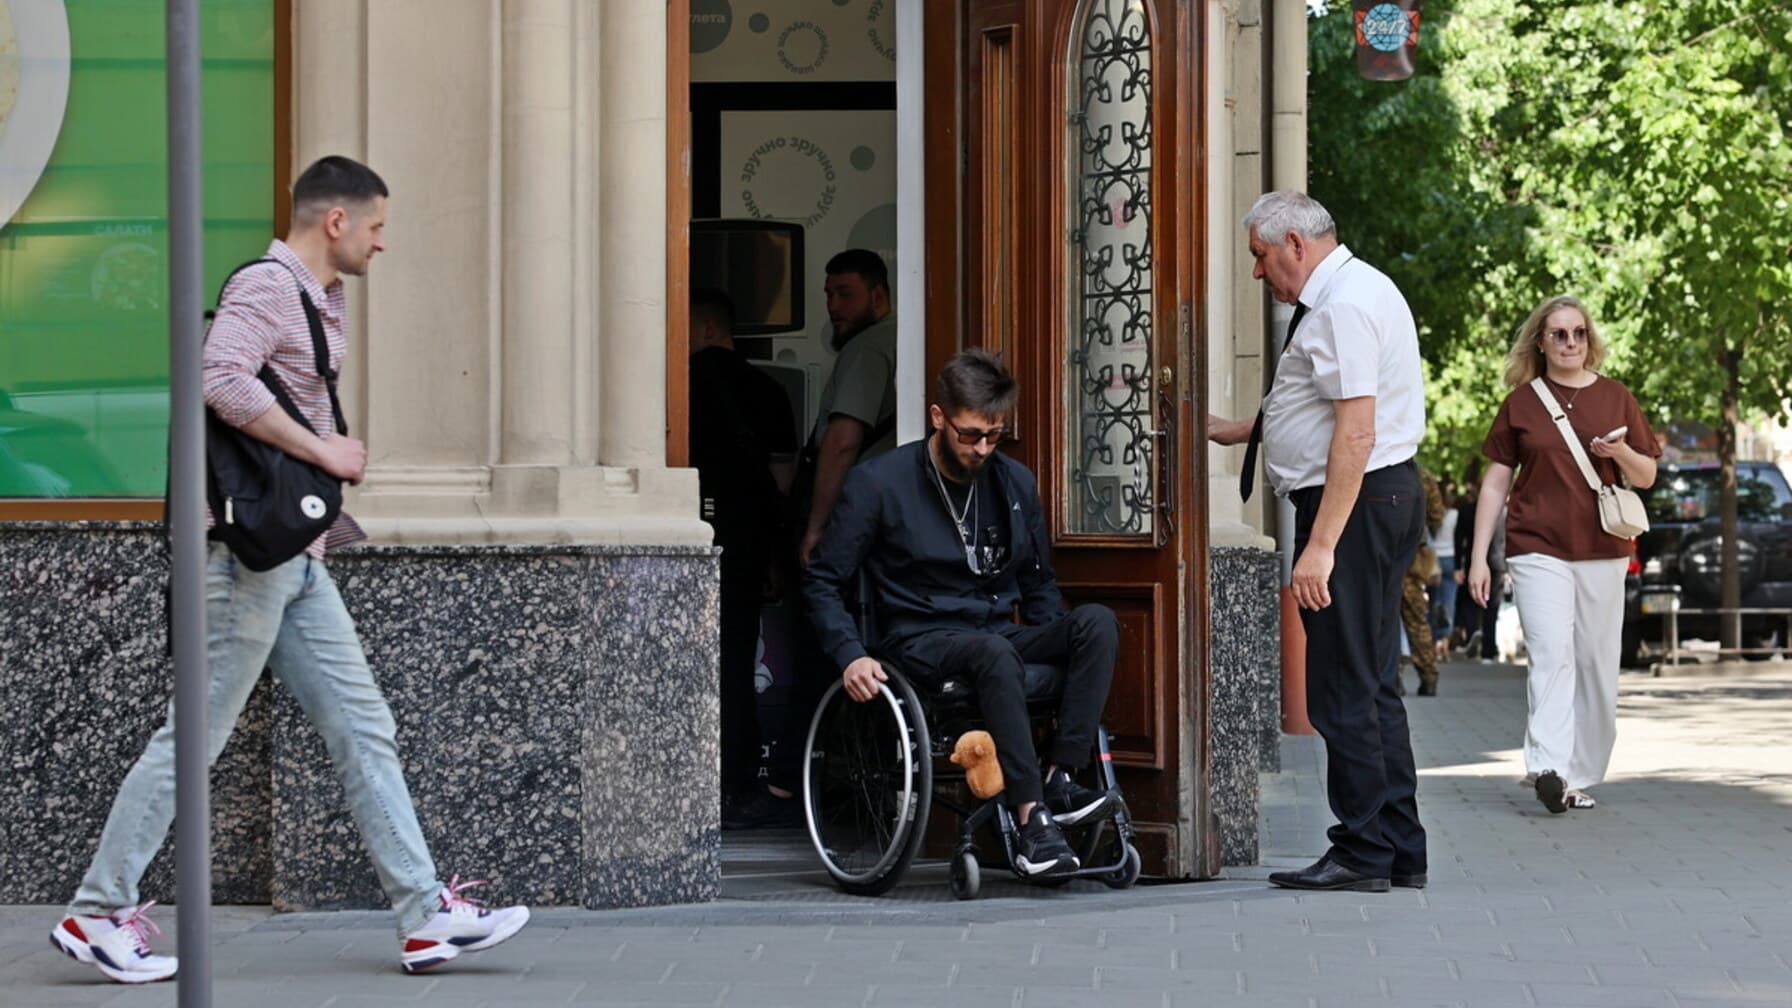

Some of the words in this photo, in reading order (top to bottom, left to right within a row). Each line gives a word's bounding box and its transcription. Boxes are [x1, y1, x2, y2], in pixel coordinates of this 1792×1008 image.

[1367, 20, 1406, 35] 24/7
[741, 137, 786, 183] зручно
[790, 137, 836, 182] зручно
[805, 184, 837, 230] зручн
